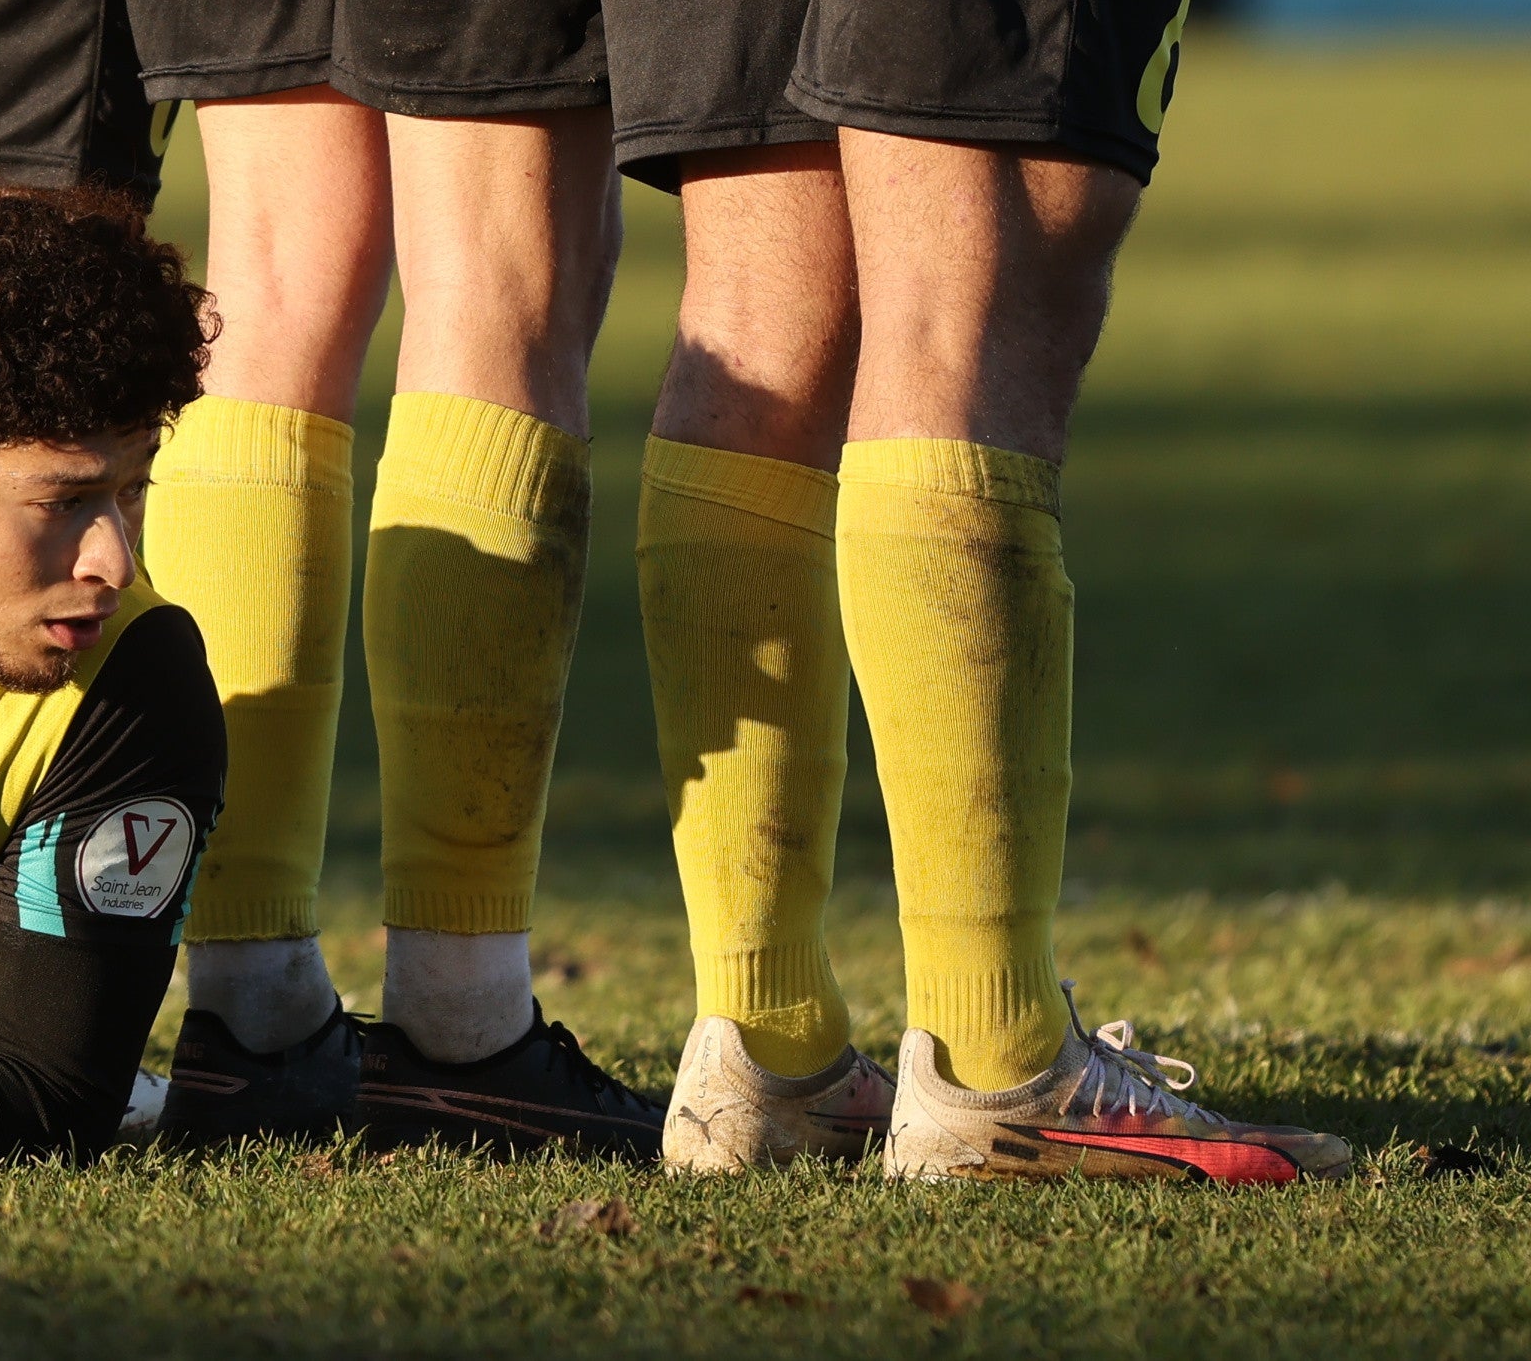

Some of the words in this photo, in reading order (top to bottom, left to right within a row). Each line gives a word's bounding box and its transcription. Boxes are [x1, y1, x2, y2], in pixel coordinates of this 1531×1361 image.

[91, 875, 130, 896] Saint
[130, 881, 162, 897] Jean
[100, 896, 145, 910] Industries
